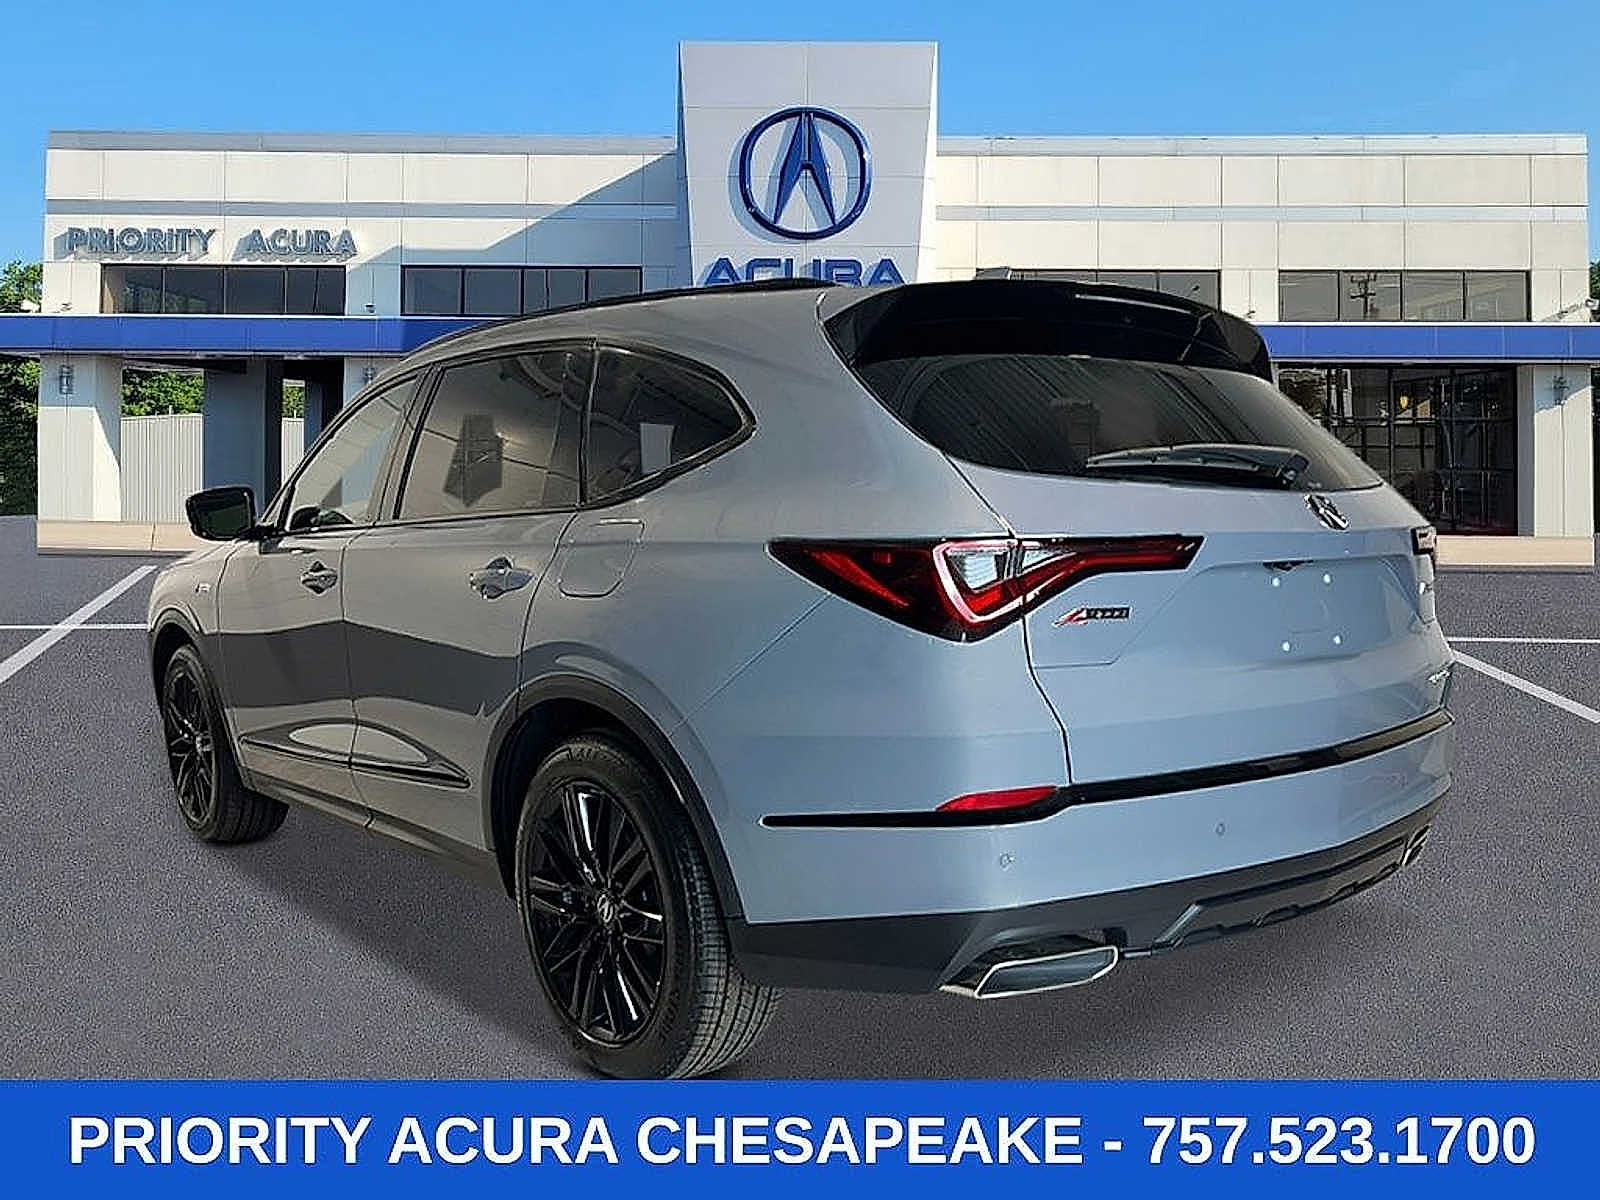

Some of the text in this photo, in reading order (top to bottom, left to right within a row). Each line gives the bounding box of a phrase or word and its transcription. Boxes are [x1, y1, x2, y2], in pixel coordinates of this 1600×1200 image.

[66, 227, 358, 256] PRIORITY ACURA
[704, 257, 906, 286] ACURA
